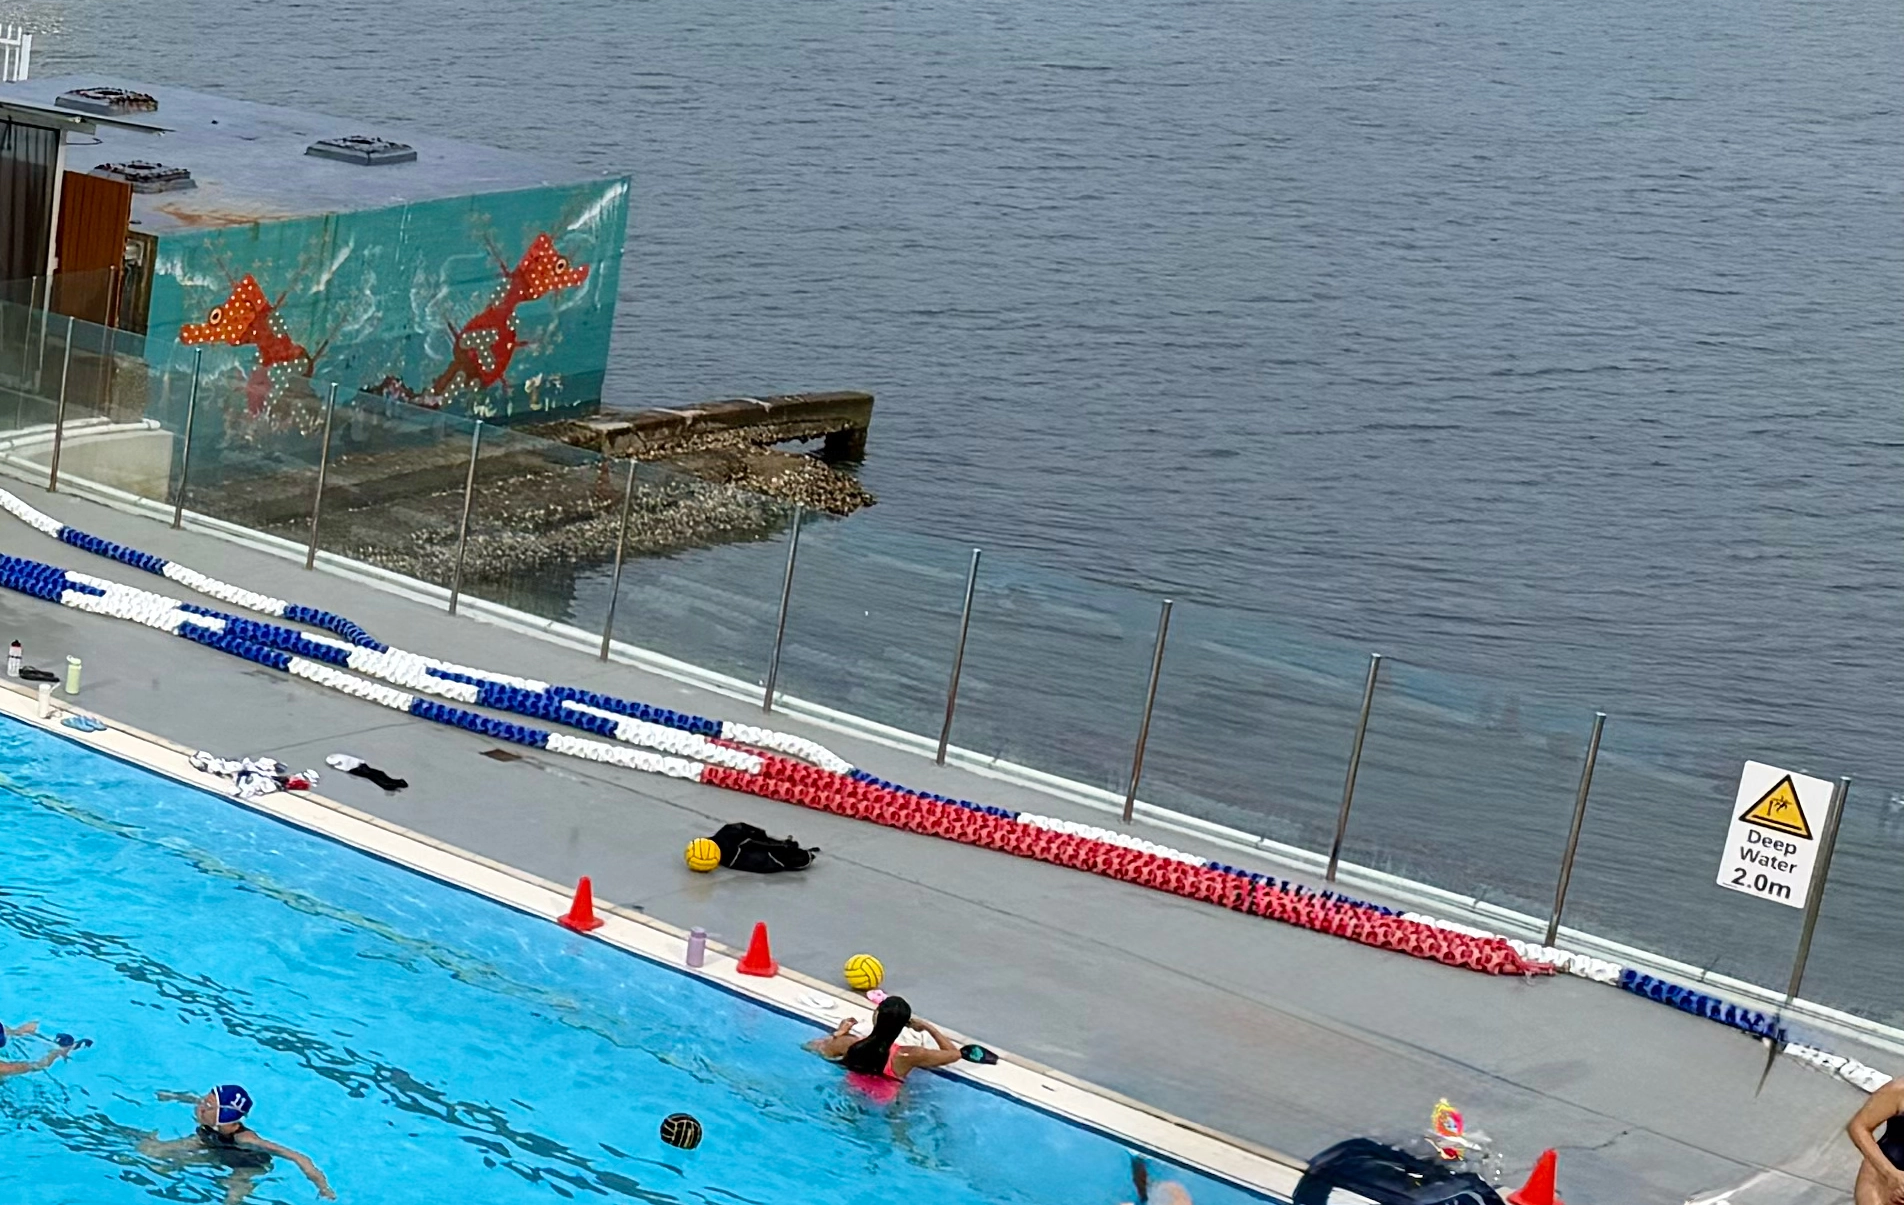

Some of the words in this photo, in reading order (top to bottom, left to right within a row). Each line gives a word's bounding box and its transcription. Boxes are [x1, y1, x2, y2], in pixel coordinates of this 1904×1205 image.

[1747, 829, 1797, 856] Deep
[1740, 846, 1798, 874] Water
[1731, 867, 1792, 899] 2.0m
